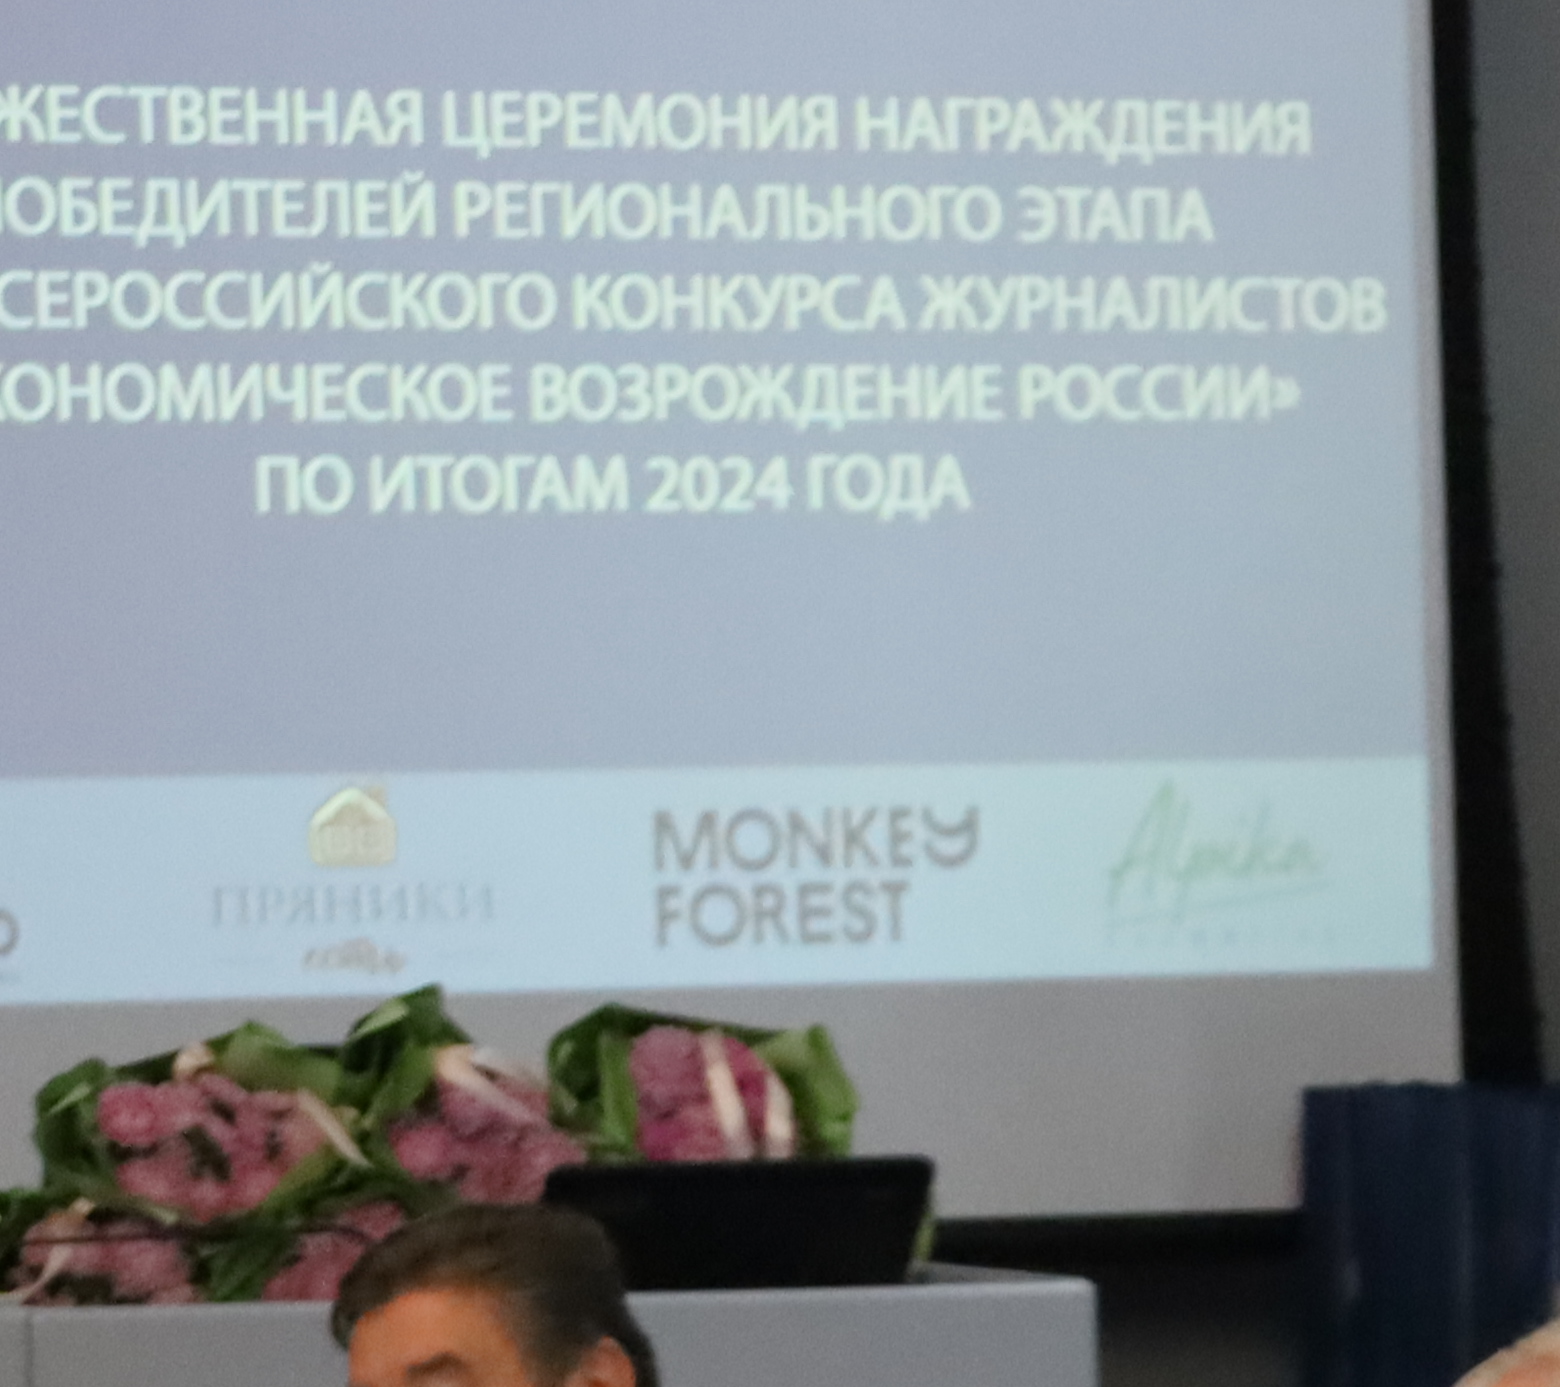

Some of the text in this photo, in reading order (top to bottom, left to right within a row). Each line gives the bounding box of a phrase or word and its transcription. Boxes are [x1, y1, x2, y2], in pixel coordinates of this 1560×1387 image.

[442, 90, 838, 160] ЦЕРЕМОНИЯ
[855, 96, 1313, 166] НАГРАЖДЕНИЯ
[0, 170, 1214, 248] ОБЕДИТЕЛЕЙ РЕГИОНАЛЬНОГО ЭТАПА
[0, 261, 1388, 333] СЕРОССИЙСКОГО КОНКУРСА ЖУРНАЛИСТОВ
[0, 362, 1301, 431] ОНОМИЧЕСКОЕ ВОЗРОЖДЕНИЕ РОССИИ»
[256, 453, 972, 522] ПО ИТОГАМ 2024 ГОДА
[653, 806, 980, 871] MONKEY
[211, 881, 495, 927] ПРЯНИКИ
[655, 880, 911, 947] FOREST
